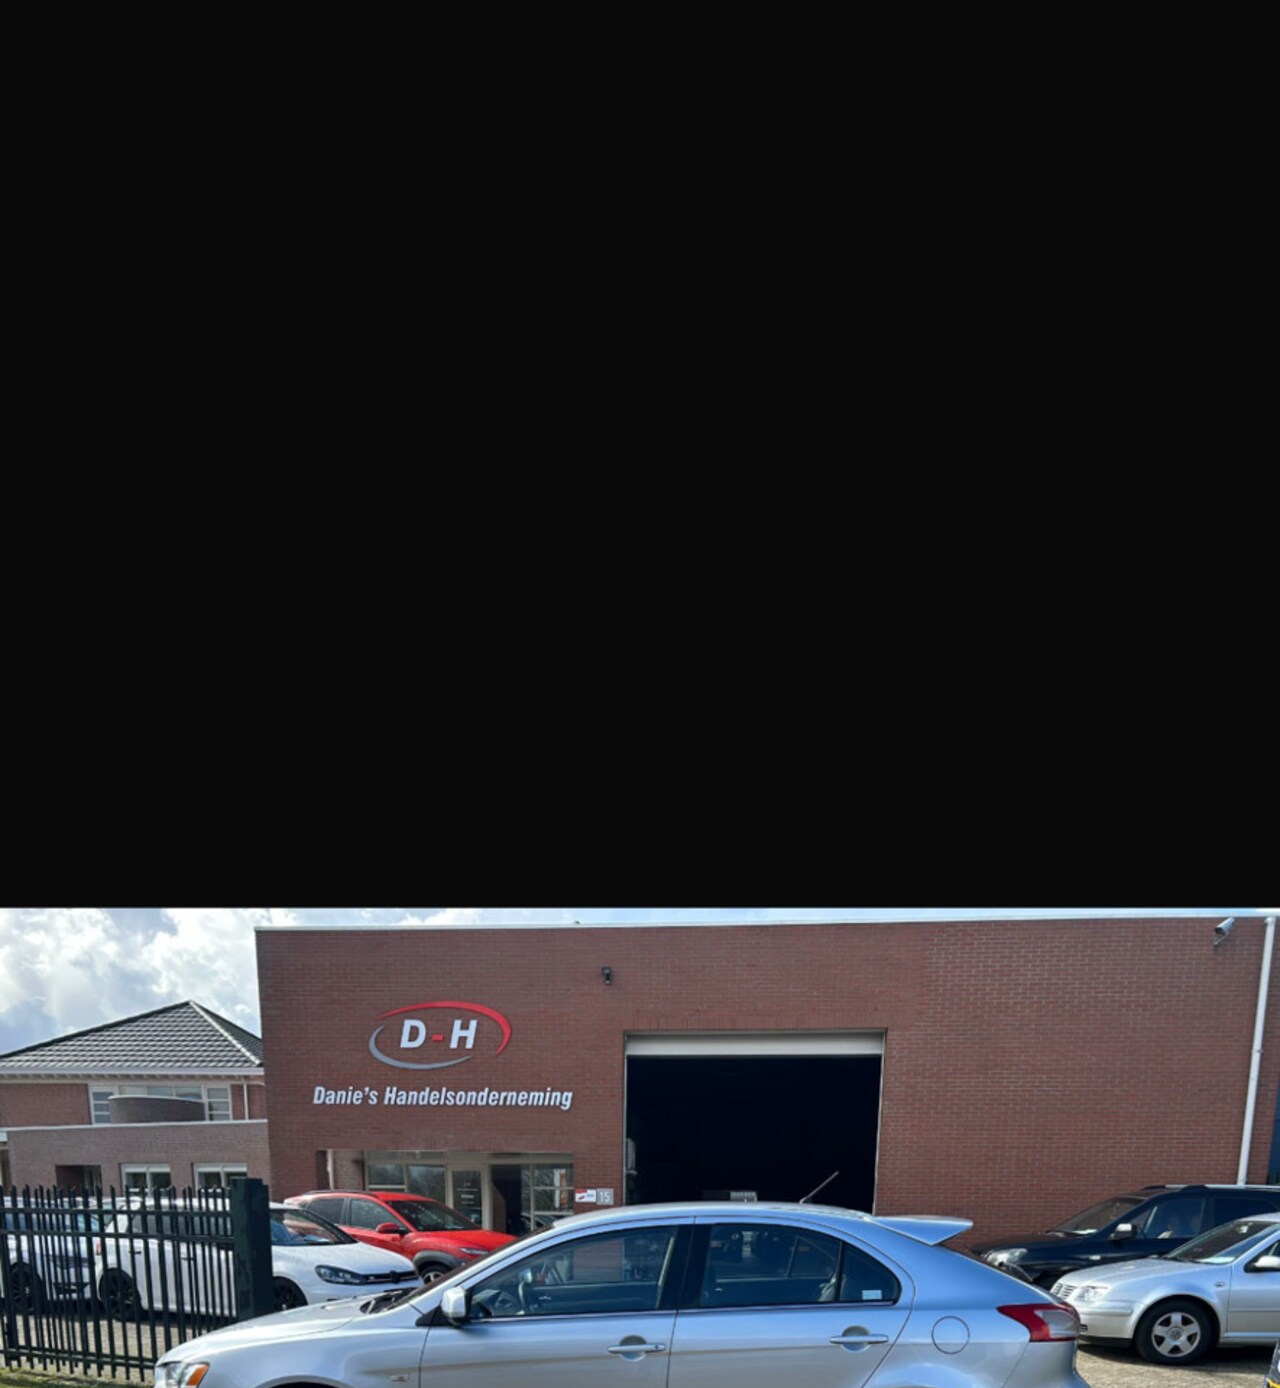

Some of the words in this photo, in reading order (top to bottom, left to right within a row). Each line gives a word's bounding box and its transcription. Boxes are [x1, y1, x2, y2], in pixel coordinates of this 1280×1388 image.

[313, 1086, 378, 1105] Danie's
[384, 1086, 573, 1111] Handelsonderneming
[600, 1191, 610, 1202] 15
